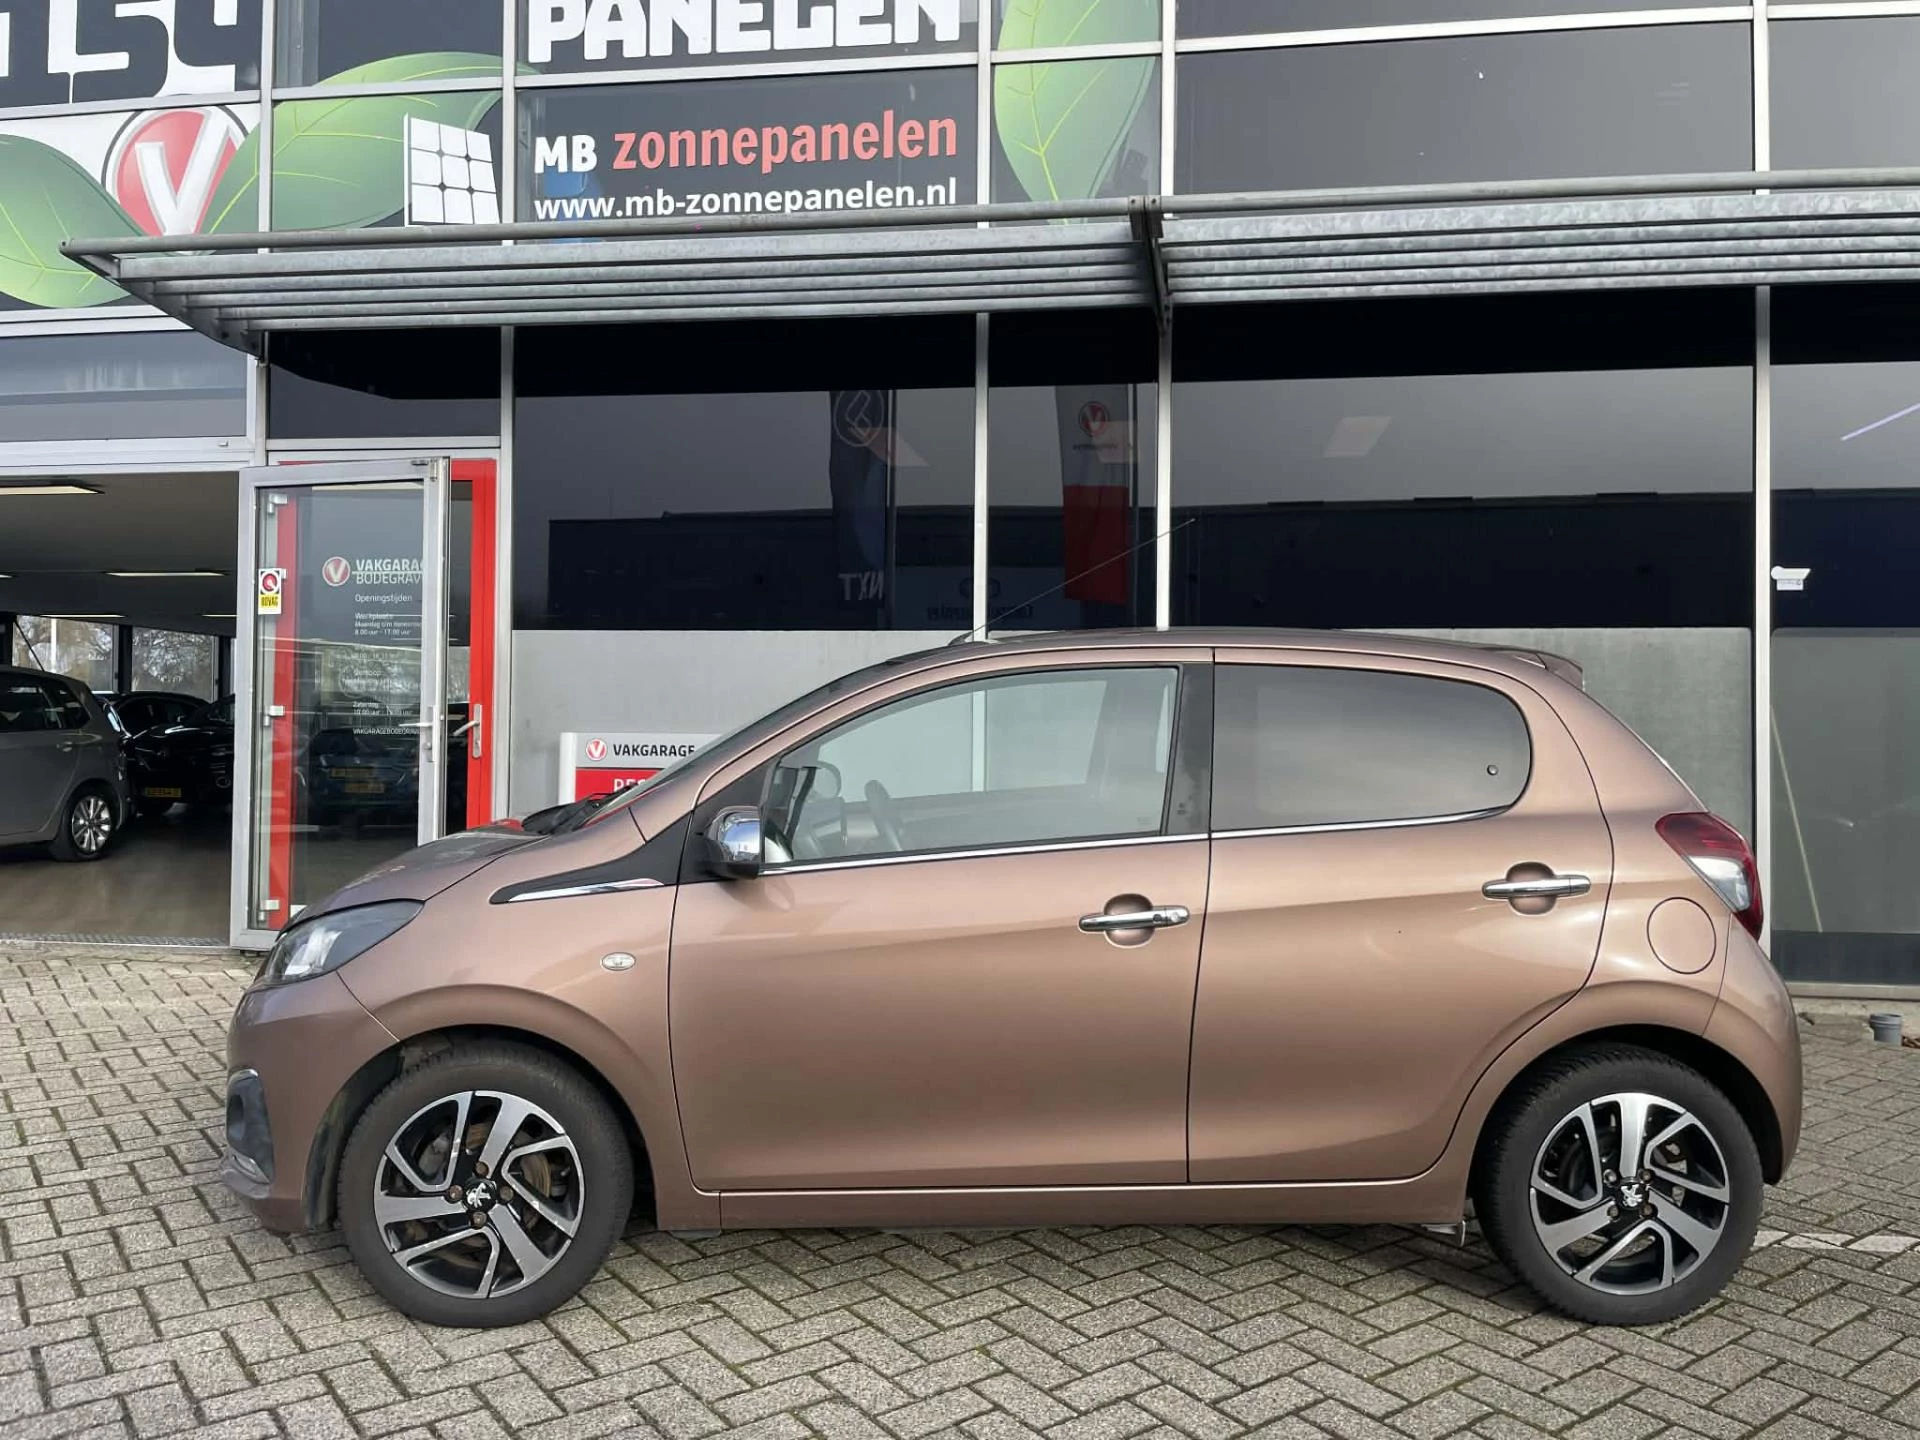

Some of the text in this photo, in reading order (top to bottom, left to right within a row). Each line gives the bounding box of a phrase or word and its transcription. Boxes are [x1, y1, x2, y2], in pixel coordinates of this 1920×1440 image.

[528, 0, 960, 63] PANELEN
[534, 109, 957, 174] MB zonnepanelen
[534, 177, 957, 220] www.mb-zonnepanelen.nl
[354, 594, 412, 604] Openingstijden
[613, 744, 695, 757] VAKGARAGE
